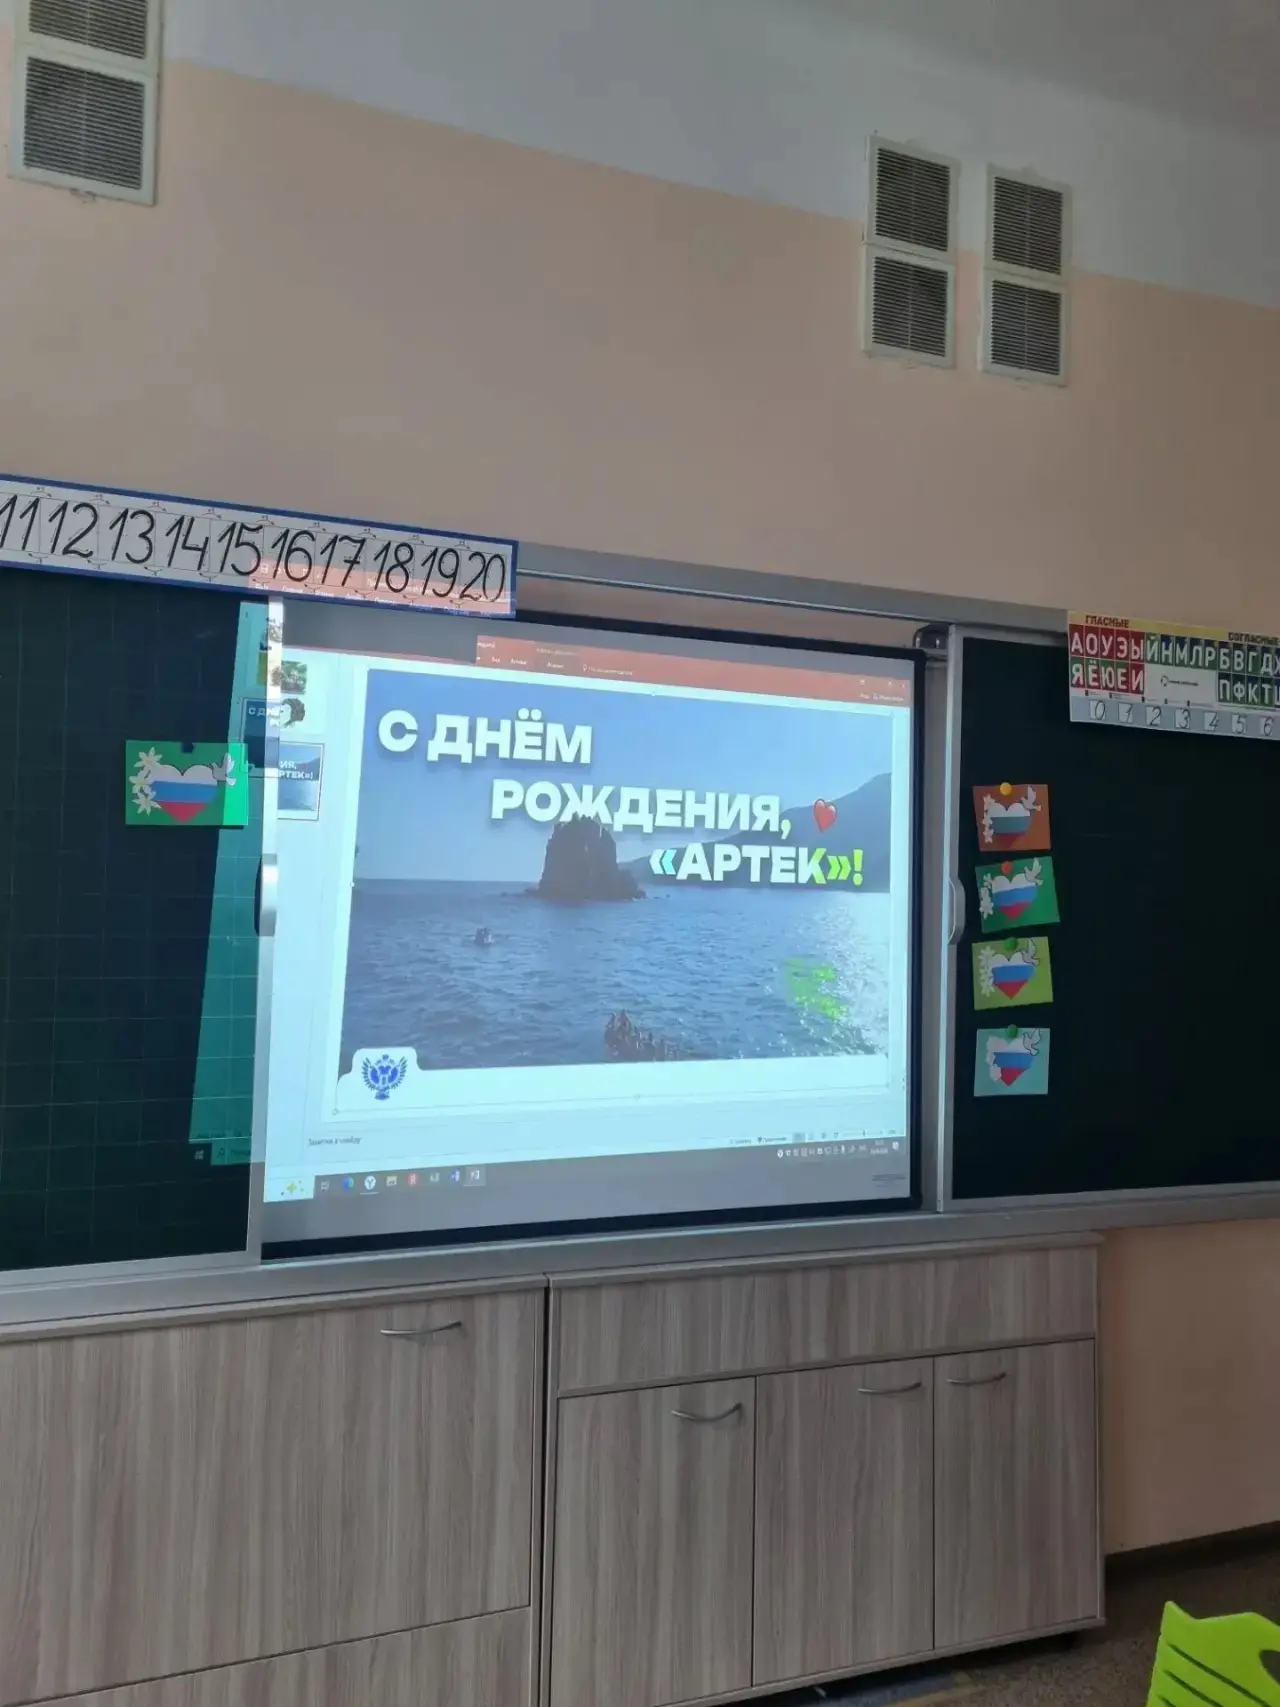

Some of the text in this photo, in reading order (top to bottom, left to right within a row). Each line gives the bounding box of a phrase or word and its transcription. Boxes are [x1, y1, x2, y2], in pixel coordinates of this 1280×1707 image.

[0, 494, 505, 602] 11 12 13 14 15 16 17 18 19 20
[1085, 615, 1130, 628] ГЛАСНЫЕ
[378, 708, 592, 764] С ДНЁМ
[1151, 706, 1162, 726] 2
[1180, 709, 1190, 729] 3
[1208, 711, 1219, 731] 4
[1236, 714, 1246, 733] 5
[1263, 716, 1274, 736] 6
[491, 779, 792, 839] РОЖДЕНИЯ,
[650, 842, 864, 886] «АРТЕК»!
